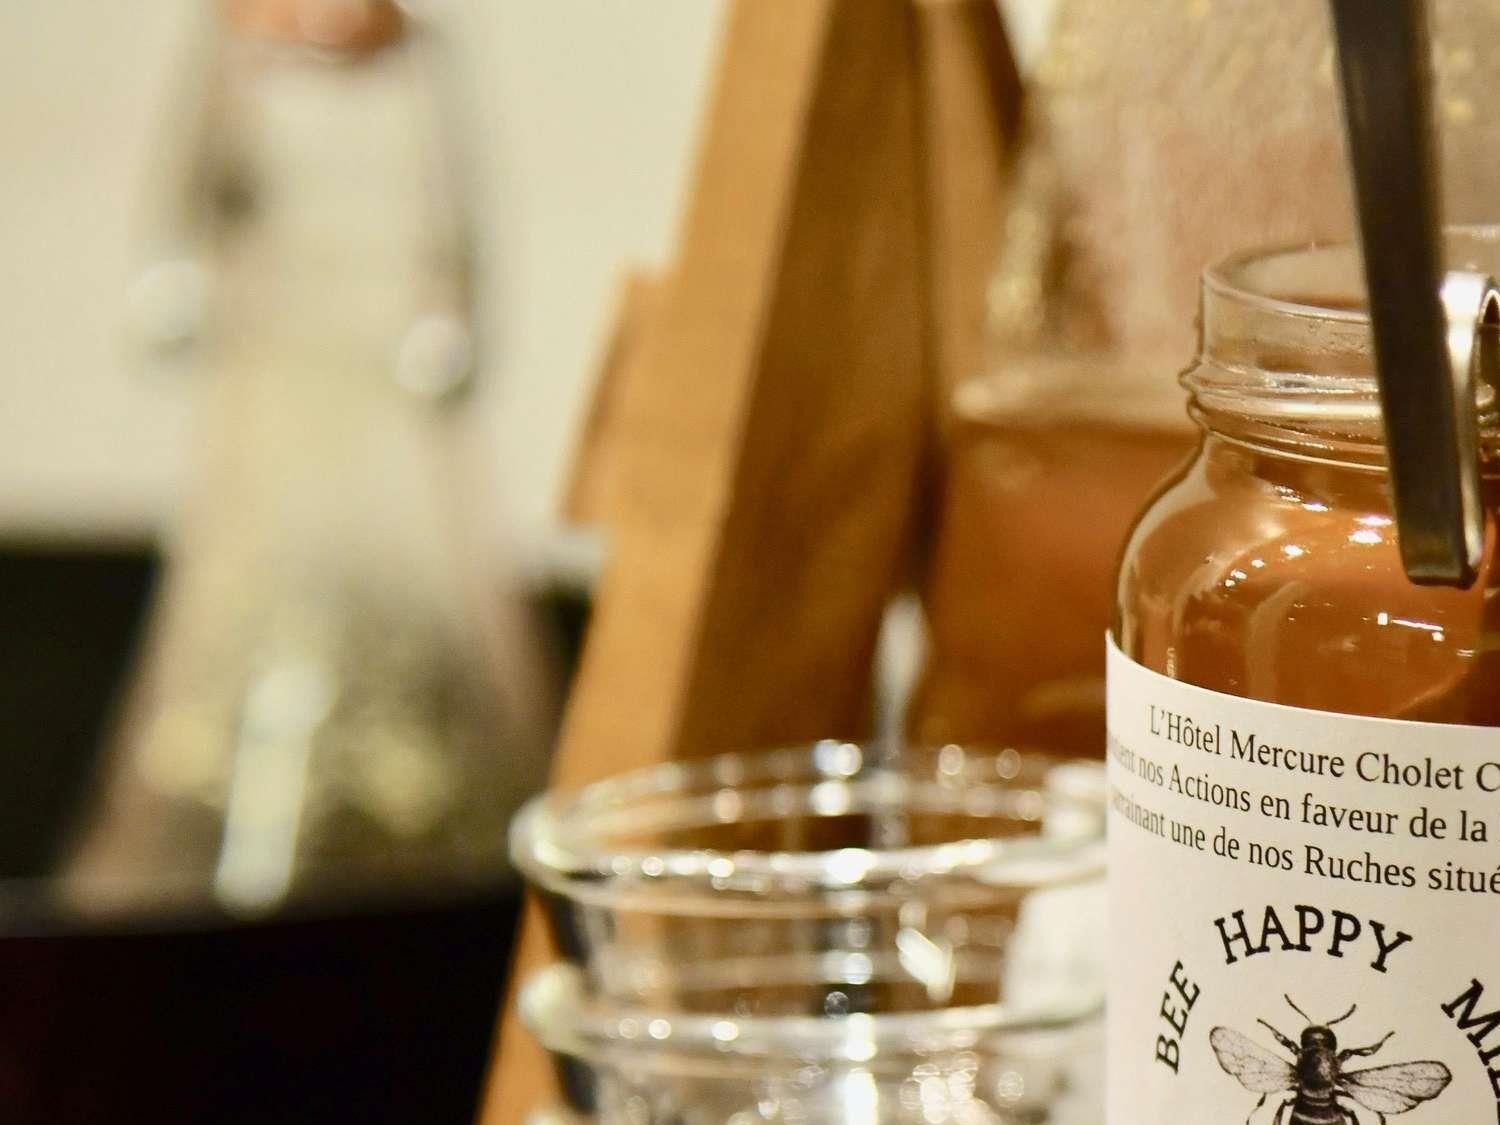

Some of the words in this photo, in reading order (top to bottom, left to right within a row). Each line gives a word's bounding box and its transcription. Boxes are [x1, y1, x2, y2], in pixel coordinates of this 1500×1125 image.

[1149, 705, 1221, 756] L'Hôtel
[1230, 729, 1345, 778] Mercure
[1356, 752, 1463, 790] Cholet
[1138, 756, 1163, 788] nos
[1168, 763, 1251, 813] Actions
[1260, 796, 1290, 821] en
[1301, 793, 1399, 836] faveur
[1409, 807, 1447, 840] de
[1458, 810, 1488, 843] la
[1170, 820, 1206, 851] une
[1213, 826, 1240, 860] de
[1248, 843, 1294, 872] nos
[1304, 844, 1416, 888] Ruches
[1156, 961, 1200, 1075] BEE
[1214, 904, 1413, 974] HAPPY
